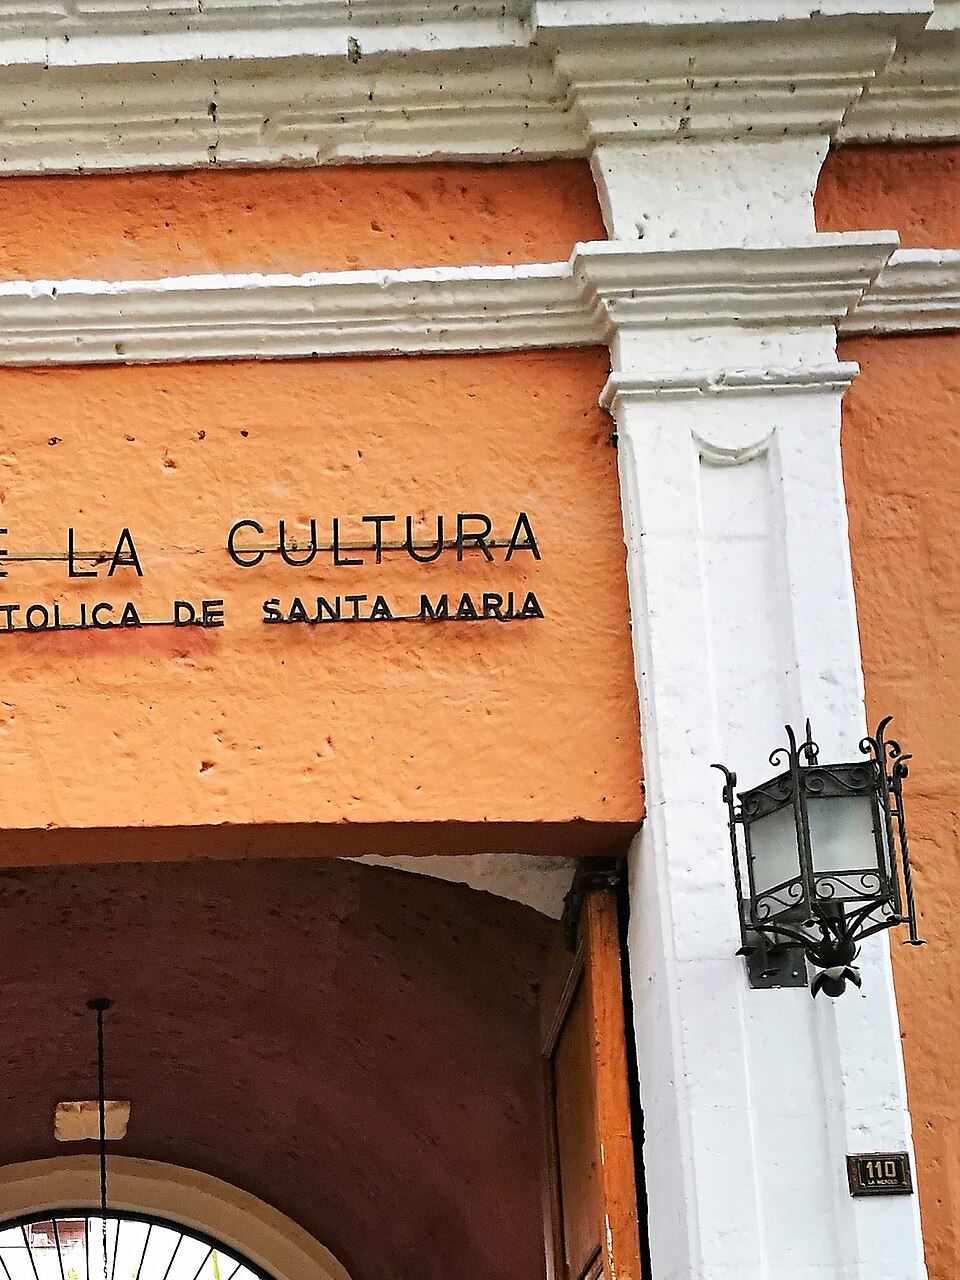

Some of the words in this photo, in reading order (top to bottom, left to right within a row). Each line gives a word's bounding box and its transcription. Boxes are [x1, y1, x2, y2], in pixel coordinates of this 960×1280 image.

[68, 527, 144, 578] LA
[226, 512, 542, 567] CULTURA
[173, 598, 225, 628] DE
[262, 593, 392, 624] SANTA
[419, 590, 545, 621] MARIA
[866, 1161, 897, 1178] 110
